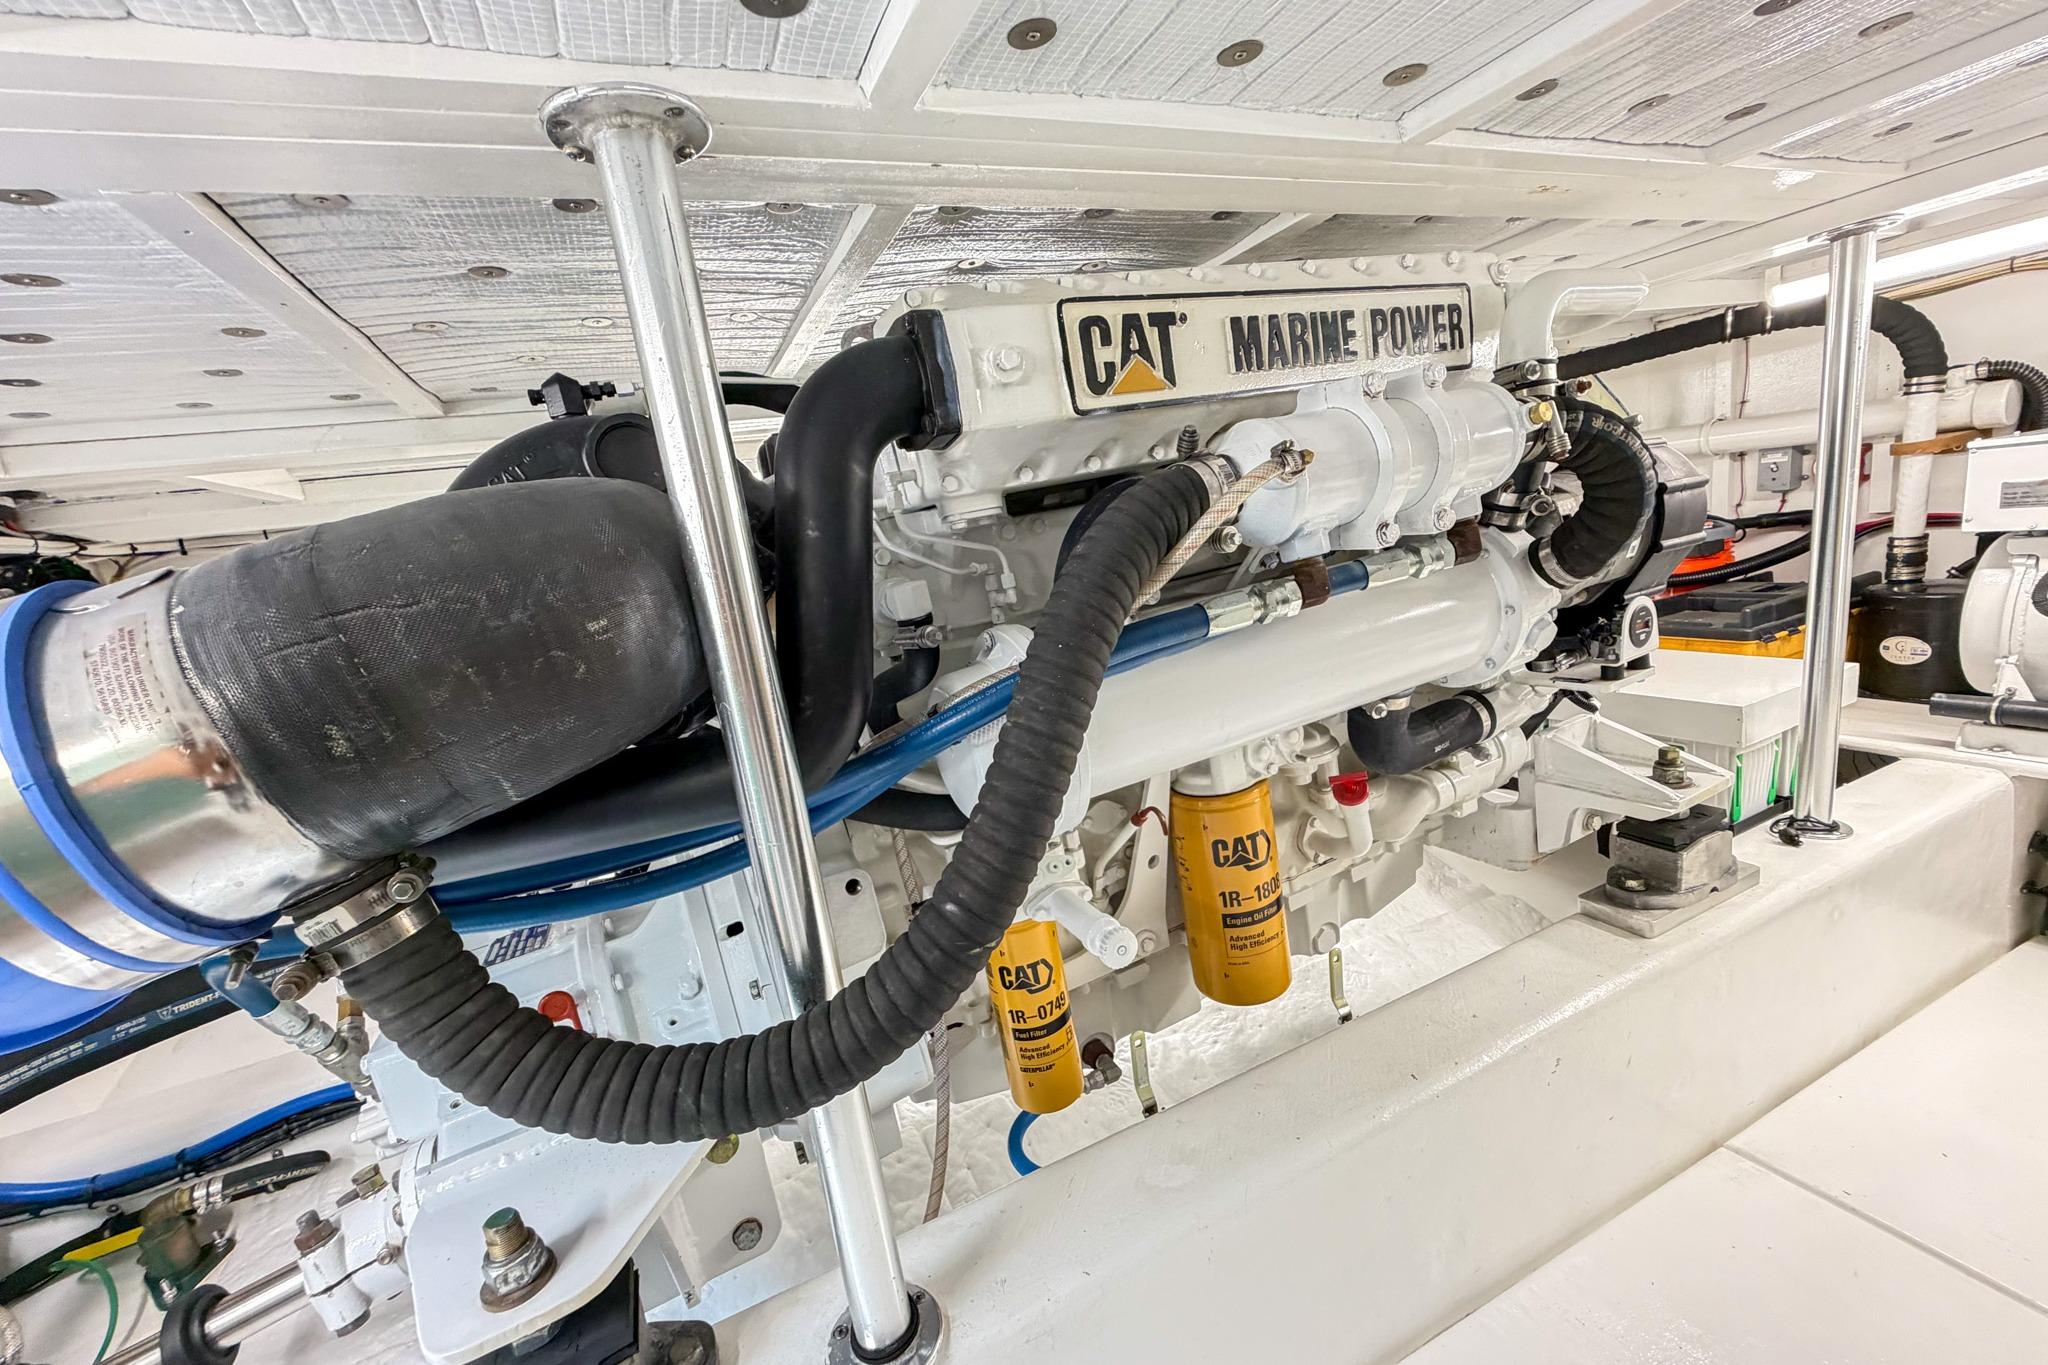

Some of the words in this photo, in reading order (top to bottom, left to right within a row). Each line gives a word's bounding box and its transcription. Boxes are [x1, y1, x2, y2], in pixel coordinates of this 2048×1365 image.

[1078, 312, 1182, 397] CAT
[1228, 309, 1359, 374] MARINE
[1368, 303, 1466, 360] POWER
[123, 664, 141, 702] FOLLOWING
[136, 675, 150, 699] UNDER
[1211, 829, 1271, 871] CAT
[1226, 915, 1252, 926] Engine
[1253, 912, 1264, 921] Oil
[1229, 929, 1265, 943] Advanced
[1230, 942, 1248, 952] High
[1249, 933, 1280, 950] Efficiency
[998, 958, 1053, 994] CAT
[172, 990, 224, 1014] TRIDENT-F
[1007, 991, 1066, 1025] 1R-0749
[1015, 1031, 1030, 1039] Fuel
[1030, 1029, 1047, 1038] Filter
[1019, 1043, 1050, 1053] Advanced
[1020, 1053, 1035, 1061] High
[1036, 1043, 1065, 1059] Efficiency
